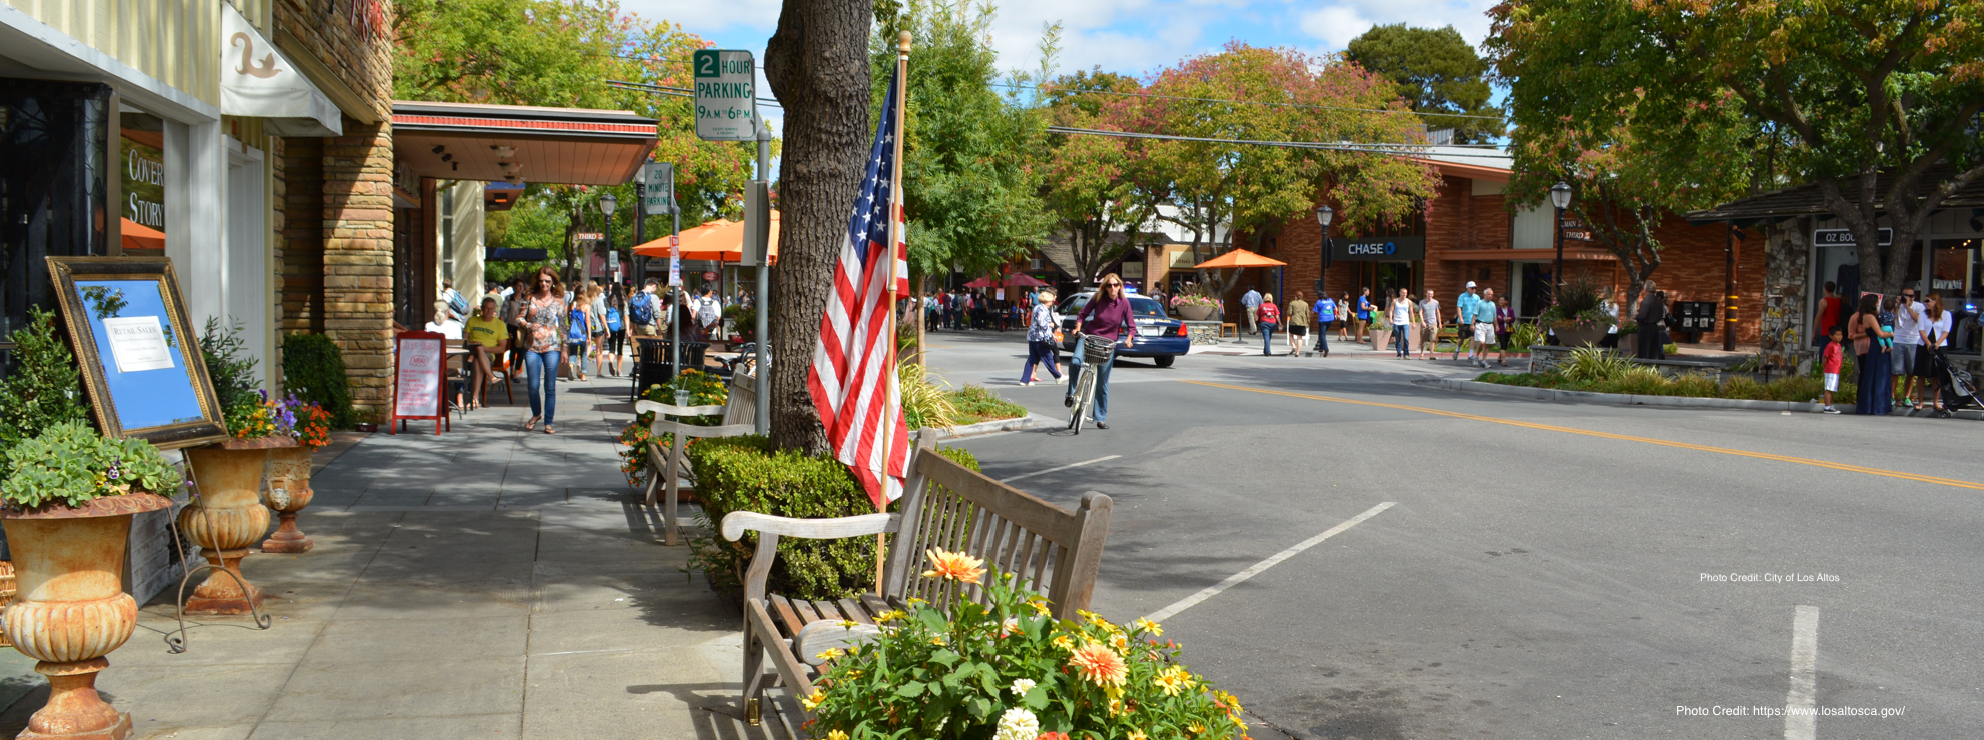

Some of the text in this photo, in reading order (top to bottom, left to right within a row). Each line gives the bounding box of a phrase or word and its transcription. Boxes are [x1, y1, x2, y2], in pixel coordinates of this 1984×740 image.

[700, 54, 750, 74] 2 HOUR
[698, 82, 750, 98] PARKING
[129, 149, 164, 186] COVER
[654, 170, 662, 179] 20
[648, 183, 668, 192] MINUTE
[647, 196, 670, 206] PARKING
[130, 192, 164, 226] STORY
[1826, 233, 1837, 242] OZ
[1348, 244, 1384, 254] CHASE
